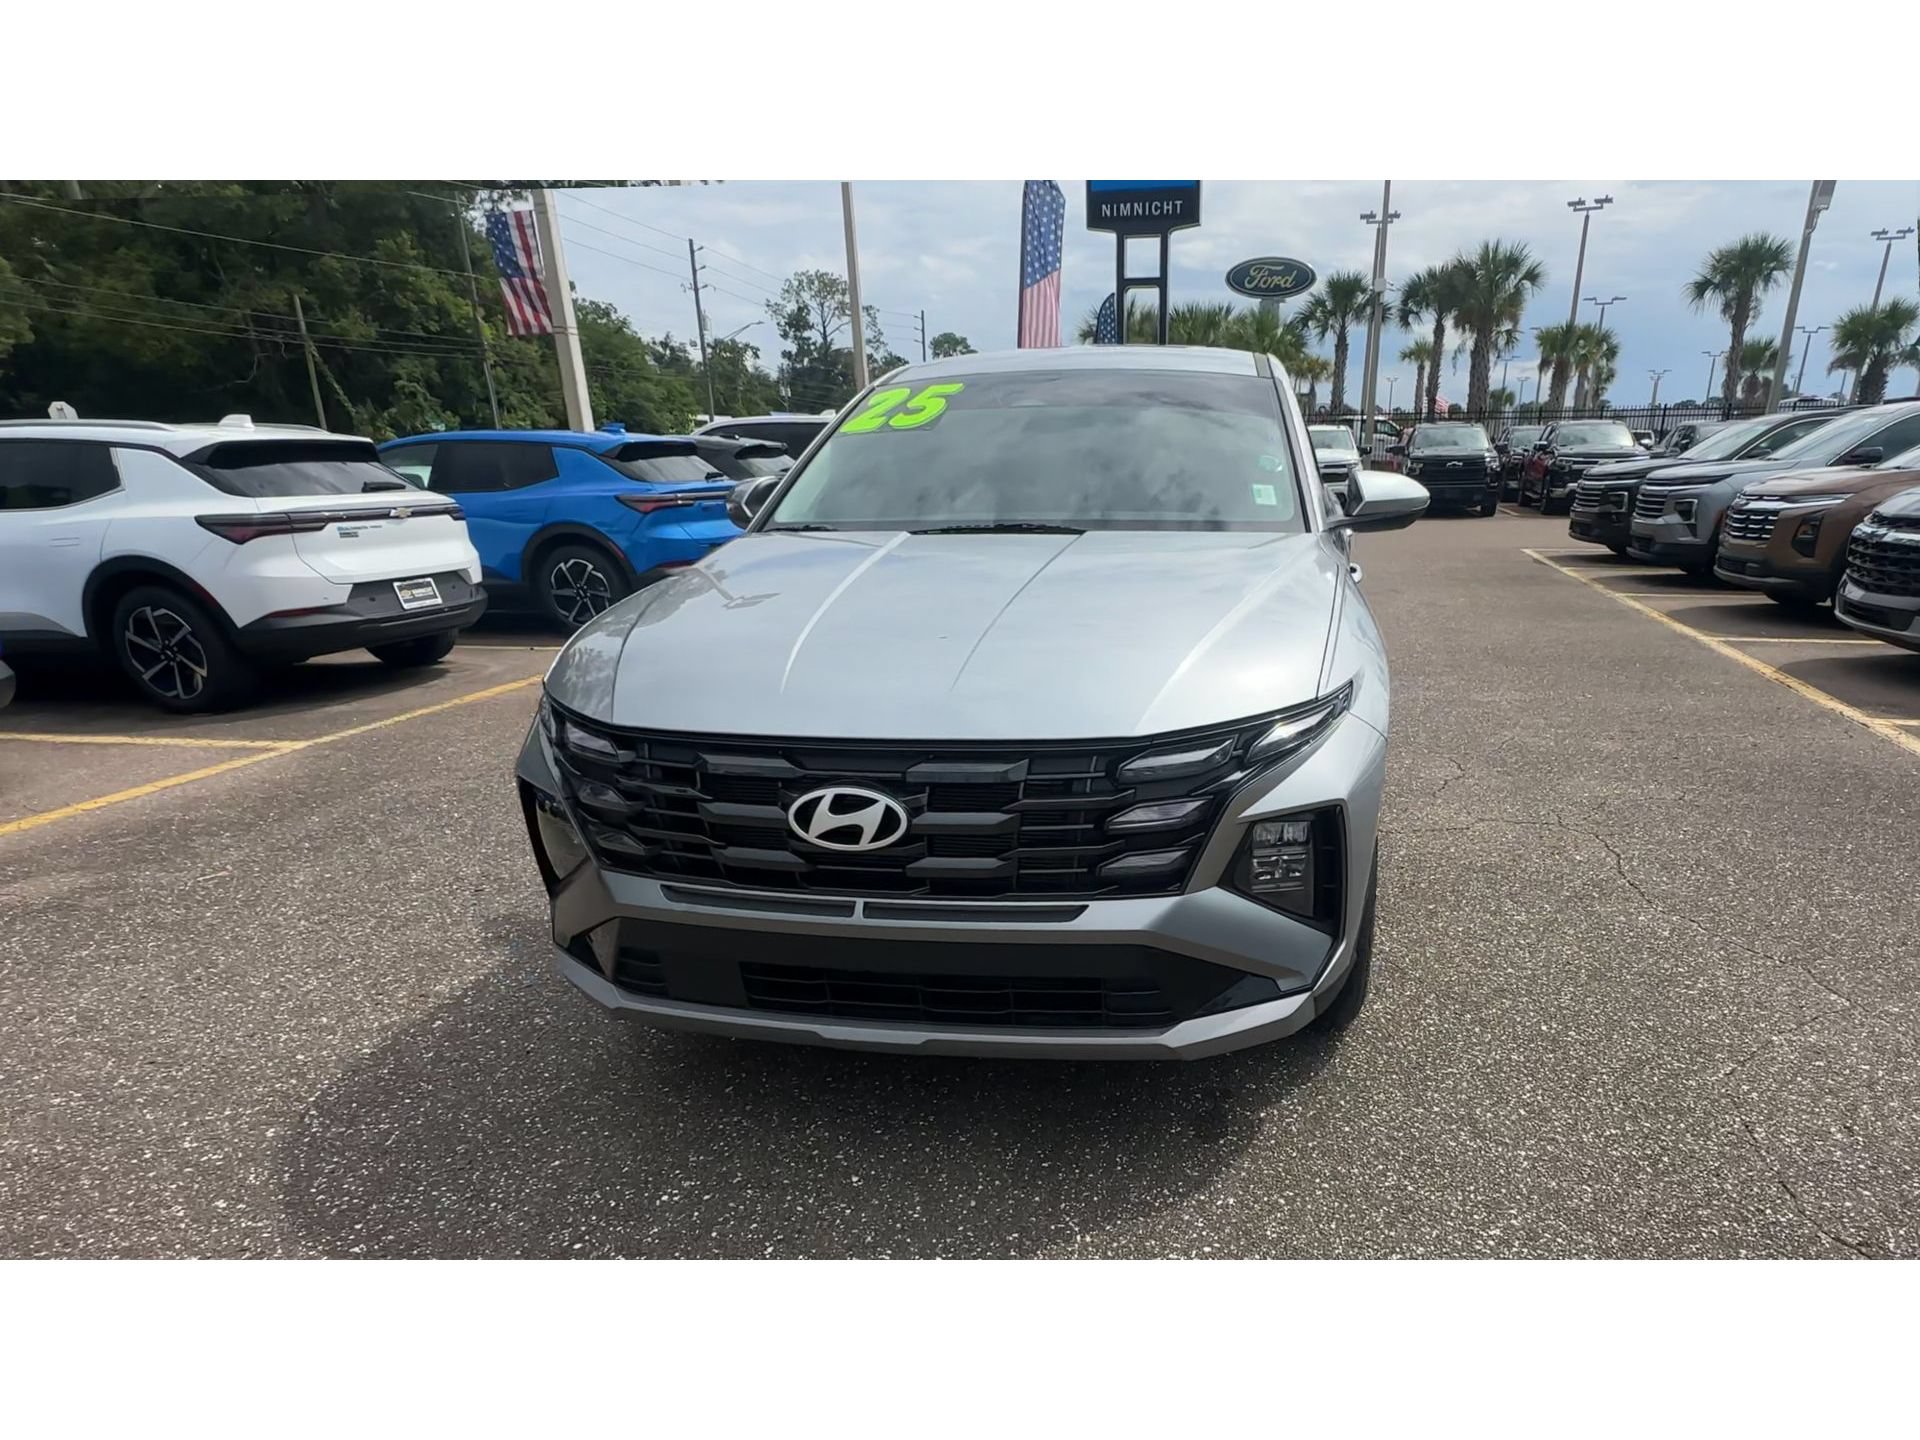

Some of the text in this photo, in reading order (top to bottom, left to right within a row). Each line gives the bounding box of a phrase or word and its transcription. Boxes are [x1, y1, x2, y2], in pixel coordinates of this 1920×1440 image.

[1101, 200, 1183, 217] NIMNICHT
[1244, 264, 1297, 289] Ford
[840, 383, 964, 434] 25
